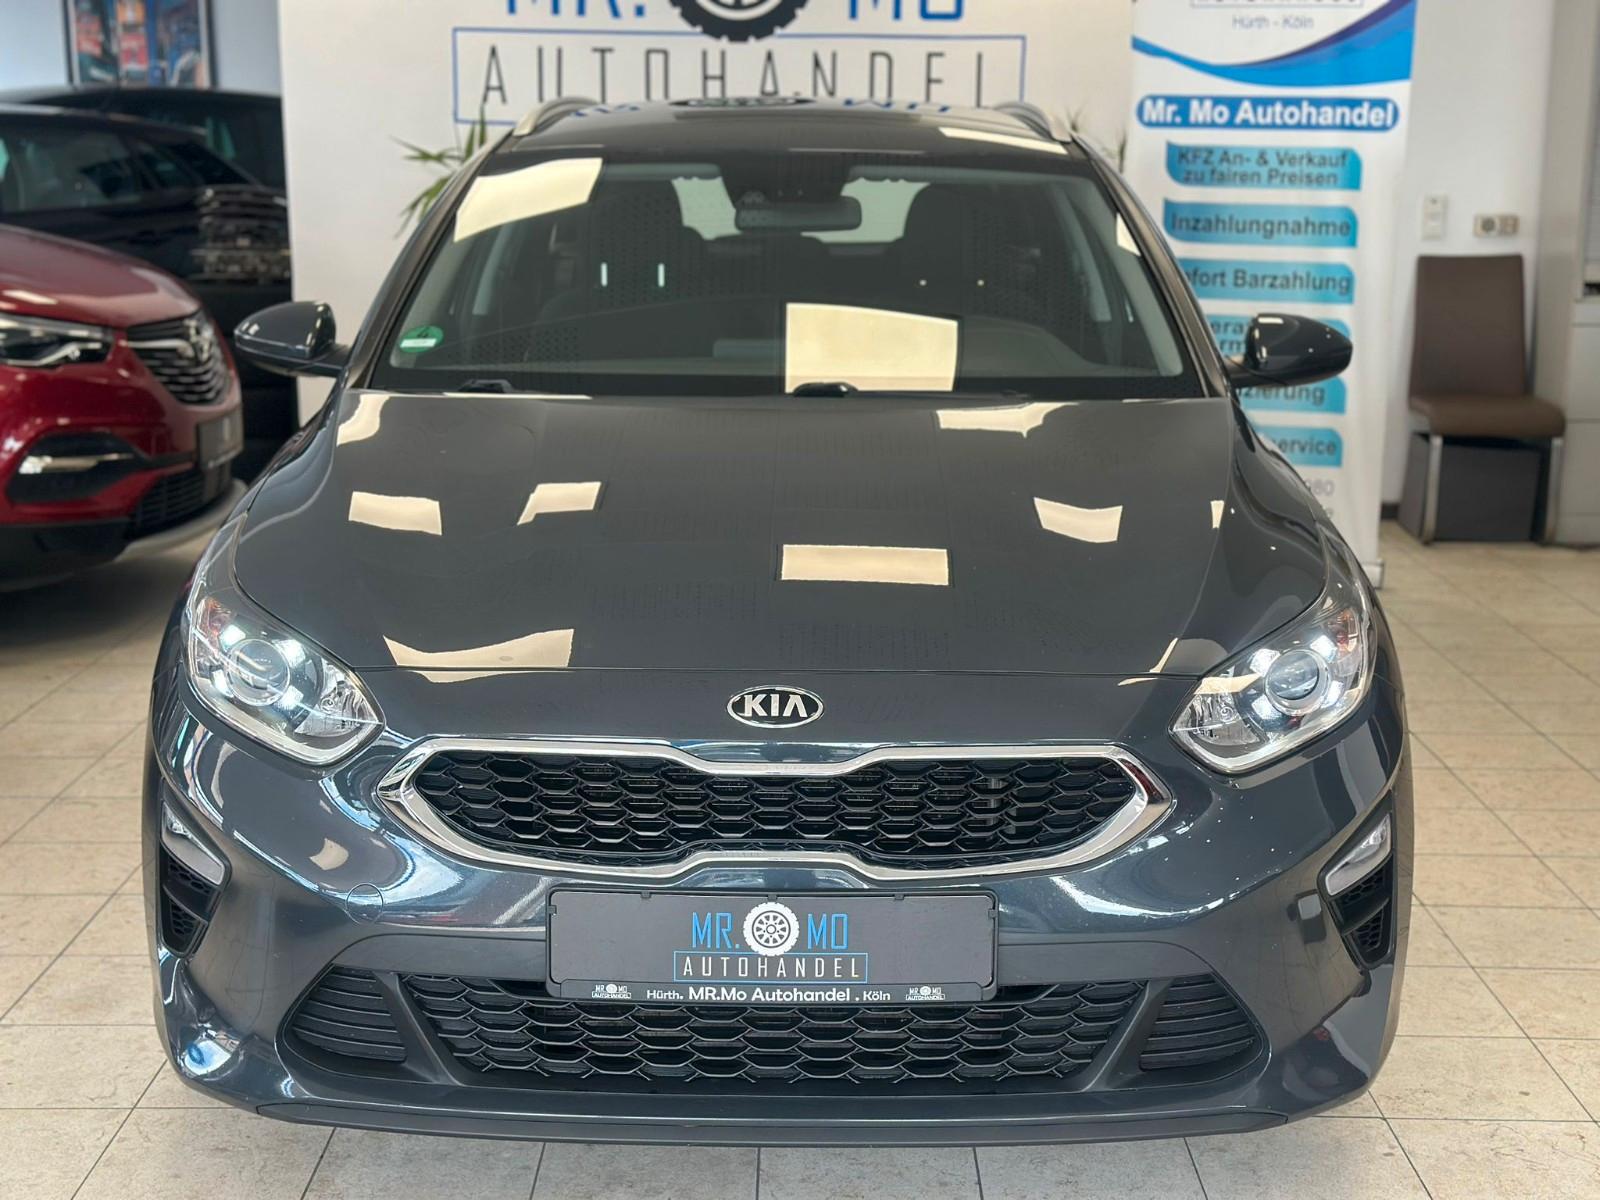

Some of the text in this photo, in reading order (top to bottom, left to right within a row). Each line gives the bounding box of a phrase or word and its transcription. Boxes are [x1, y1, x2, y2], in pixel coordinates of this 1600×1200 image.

[1142, 98, 1394, 127] Mr. Mo Autohandel
[1178, 149, 1347, 168] KFZ An- & Verkauf
[1183, 168, 1338, 186] zu fairen Preisen
[1171, 213, 1350, 239] Inzahlungnahme
[1185, 267, 1350, 296] fort Barzahlung
[743, 693, 809, 718] KIA
[692, 911, 848, 950] MR. MO
[683, 956, 860, 978] AUTOHANDEL
[689, 986, 747, 1001] MR.Mo
[751, 987, 850, 1001] Autohandel
[863, 989, 891, 1001] Köln
